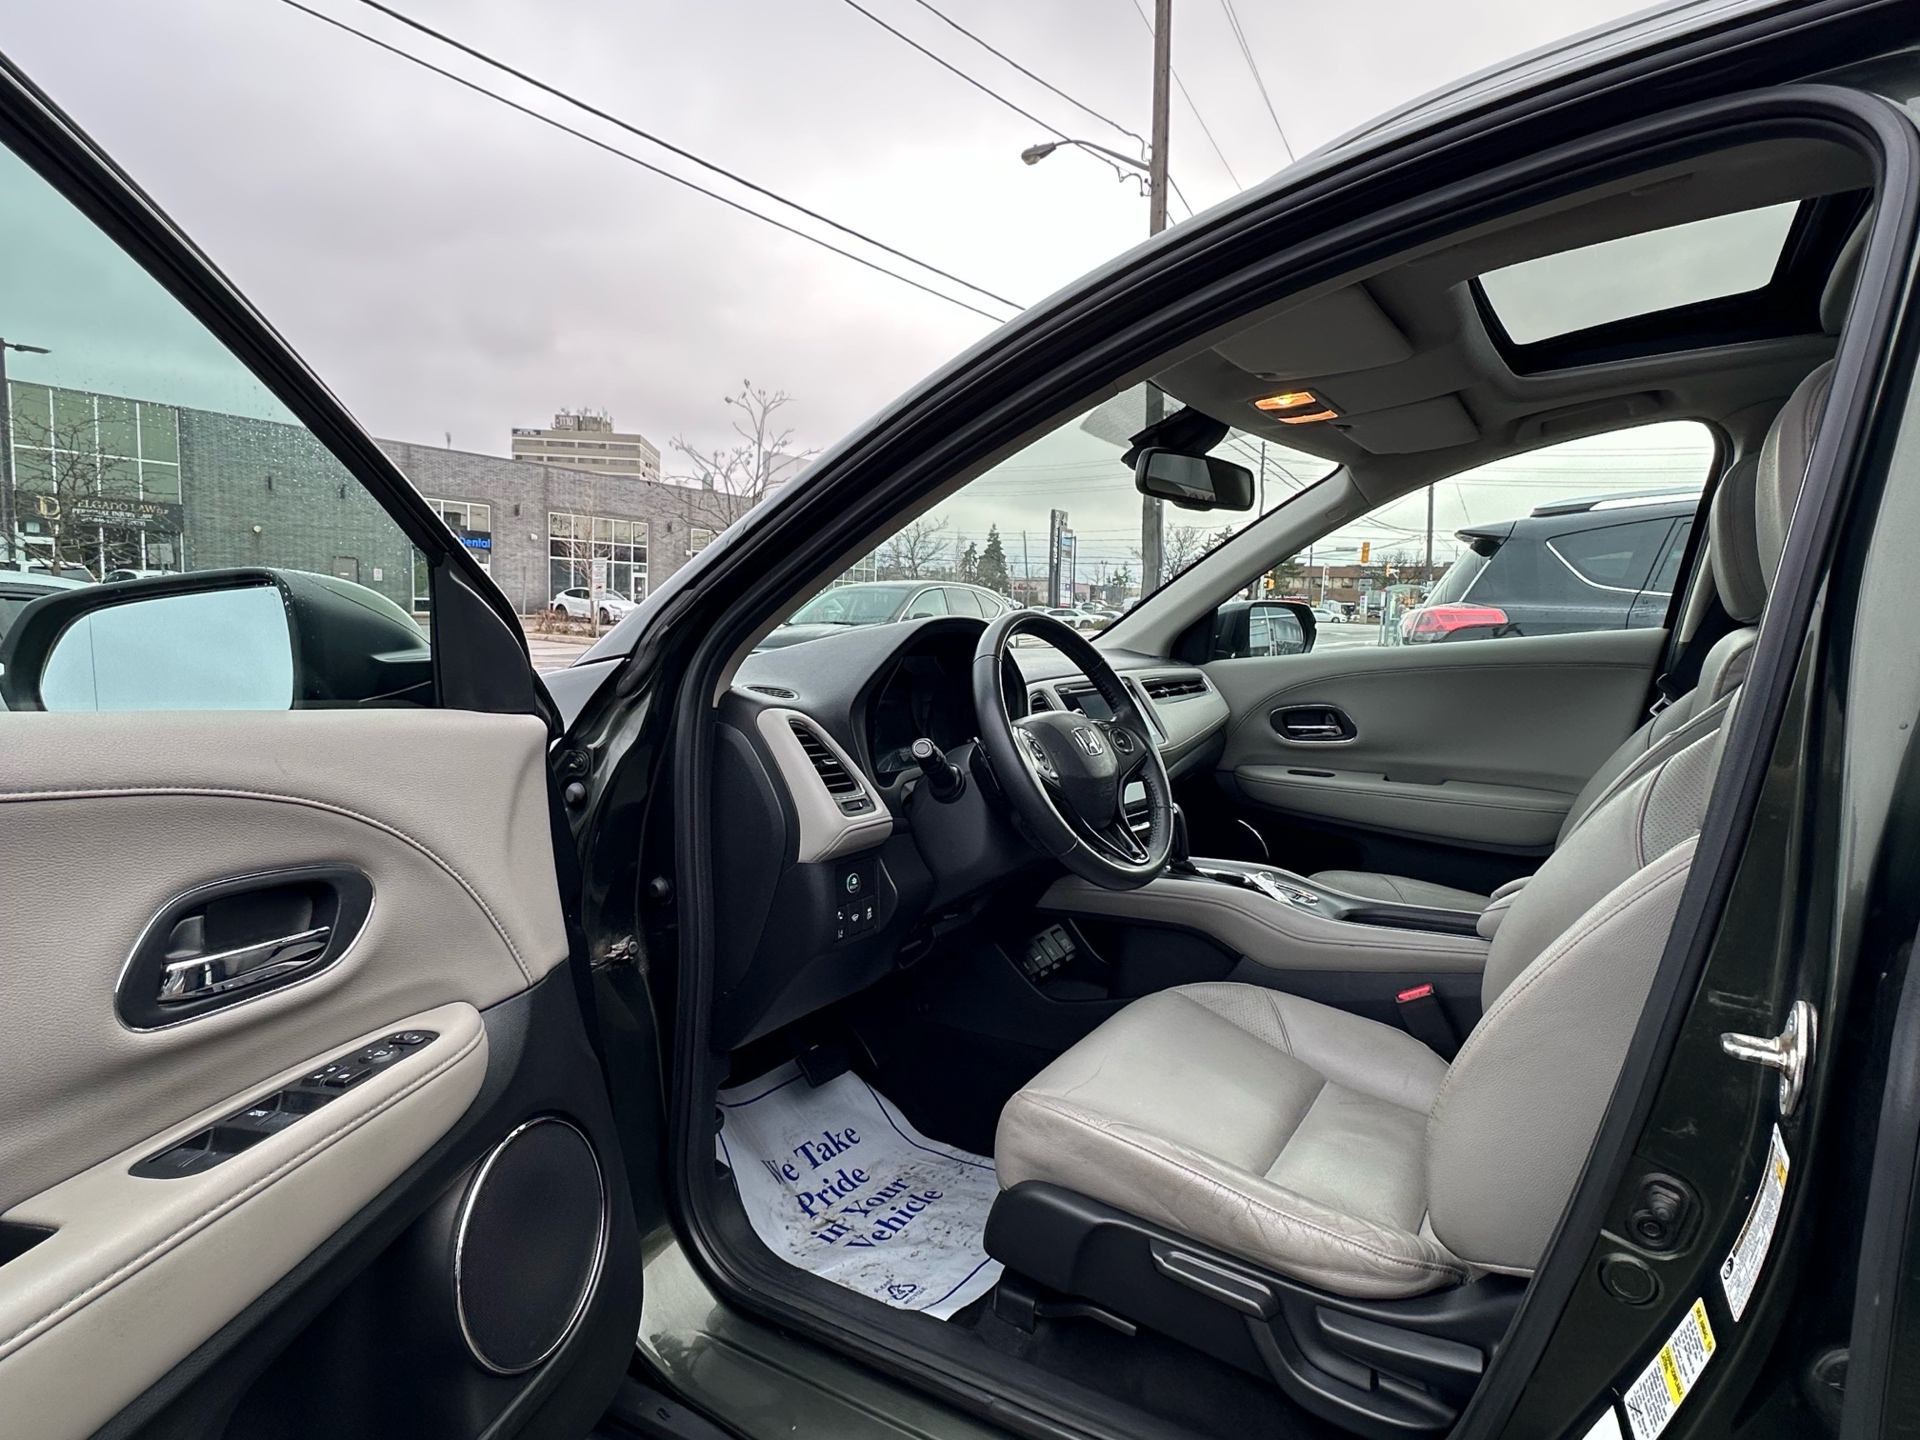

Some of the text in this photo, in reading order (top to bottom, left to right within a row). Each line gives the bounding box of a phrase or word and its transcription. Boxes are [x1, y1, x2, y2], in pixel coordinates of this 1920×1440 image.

[760, 1127, 861, 1185] We Take
[795, 1167, 870, 1219] Pride
[810, 1177, 910, 1244] in Your
[843, 1188, 943, 1248] Vehicle
